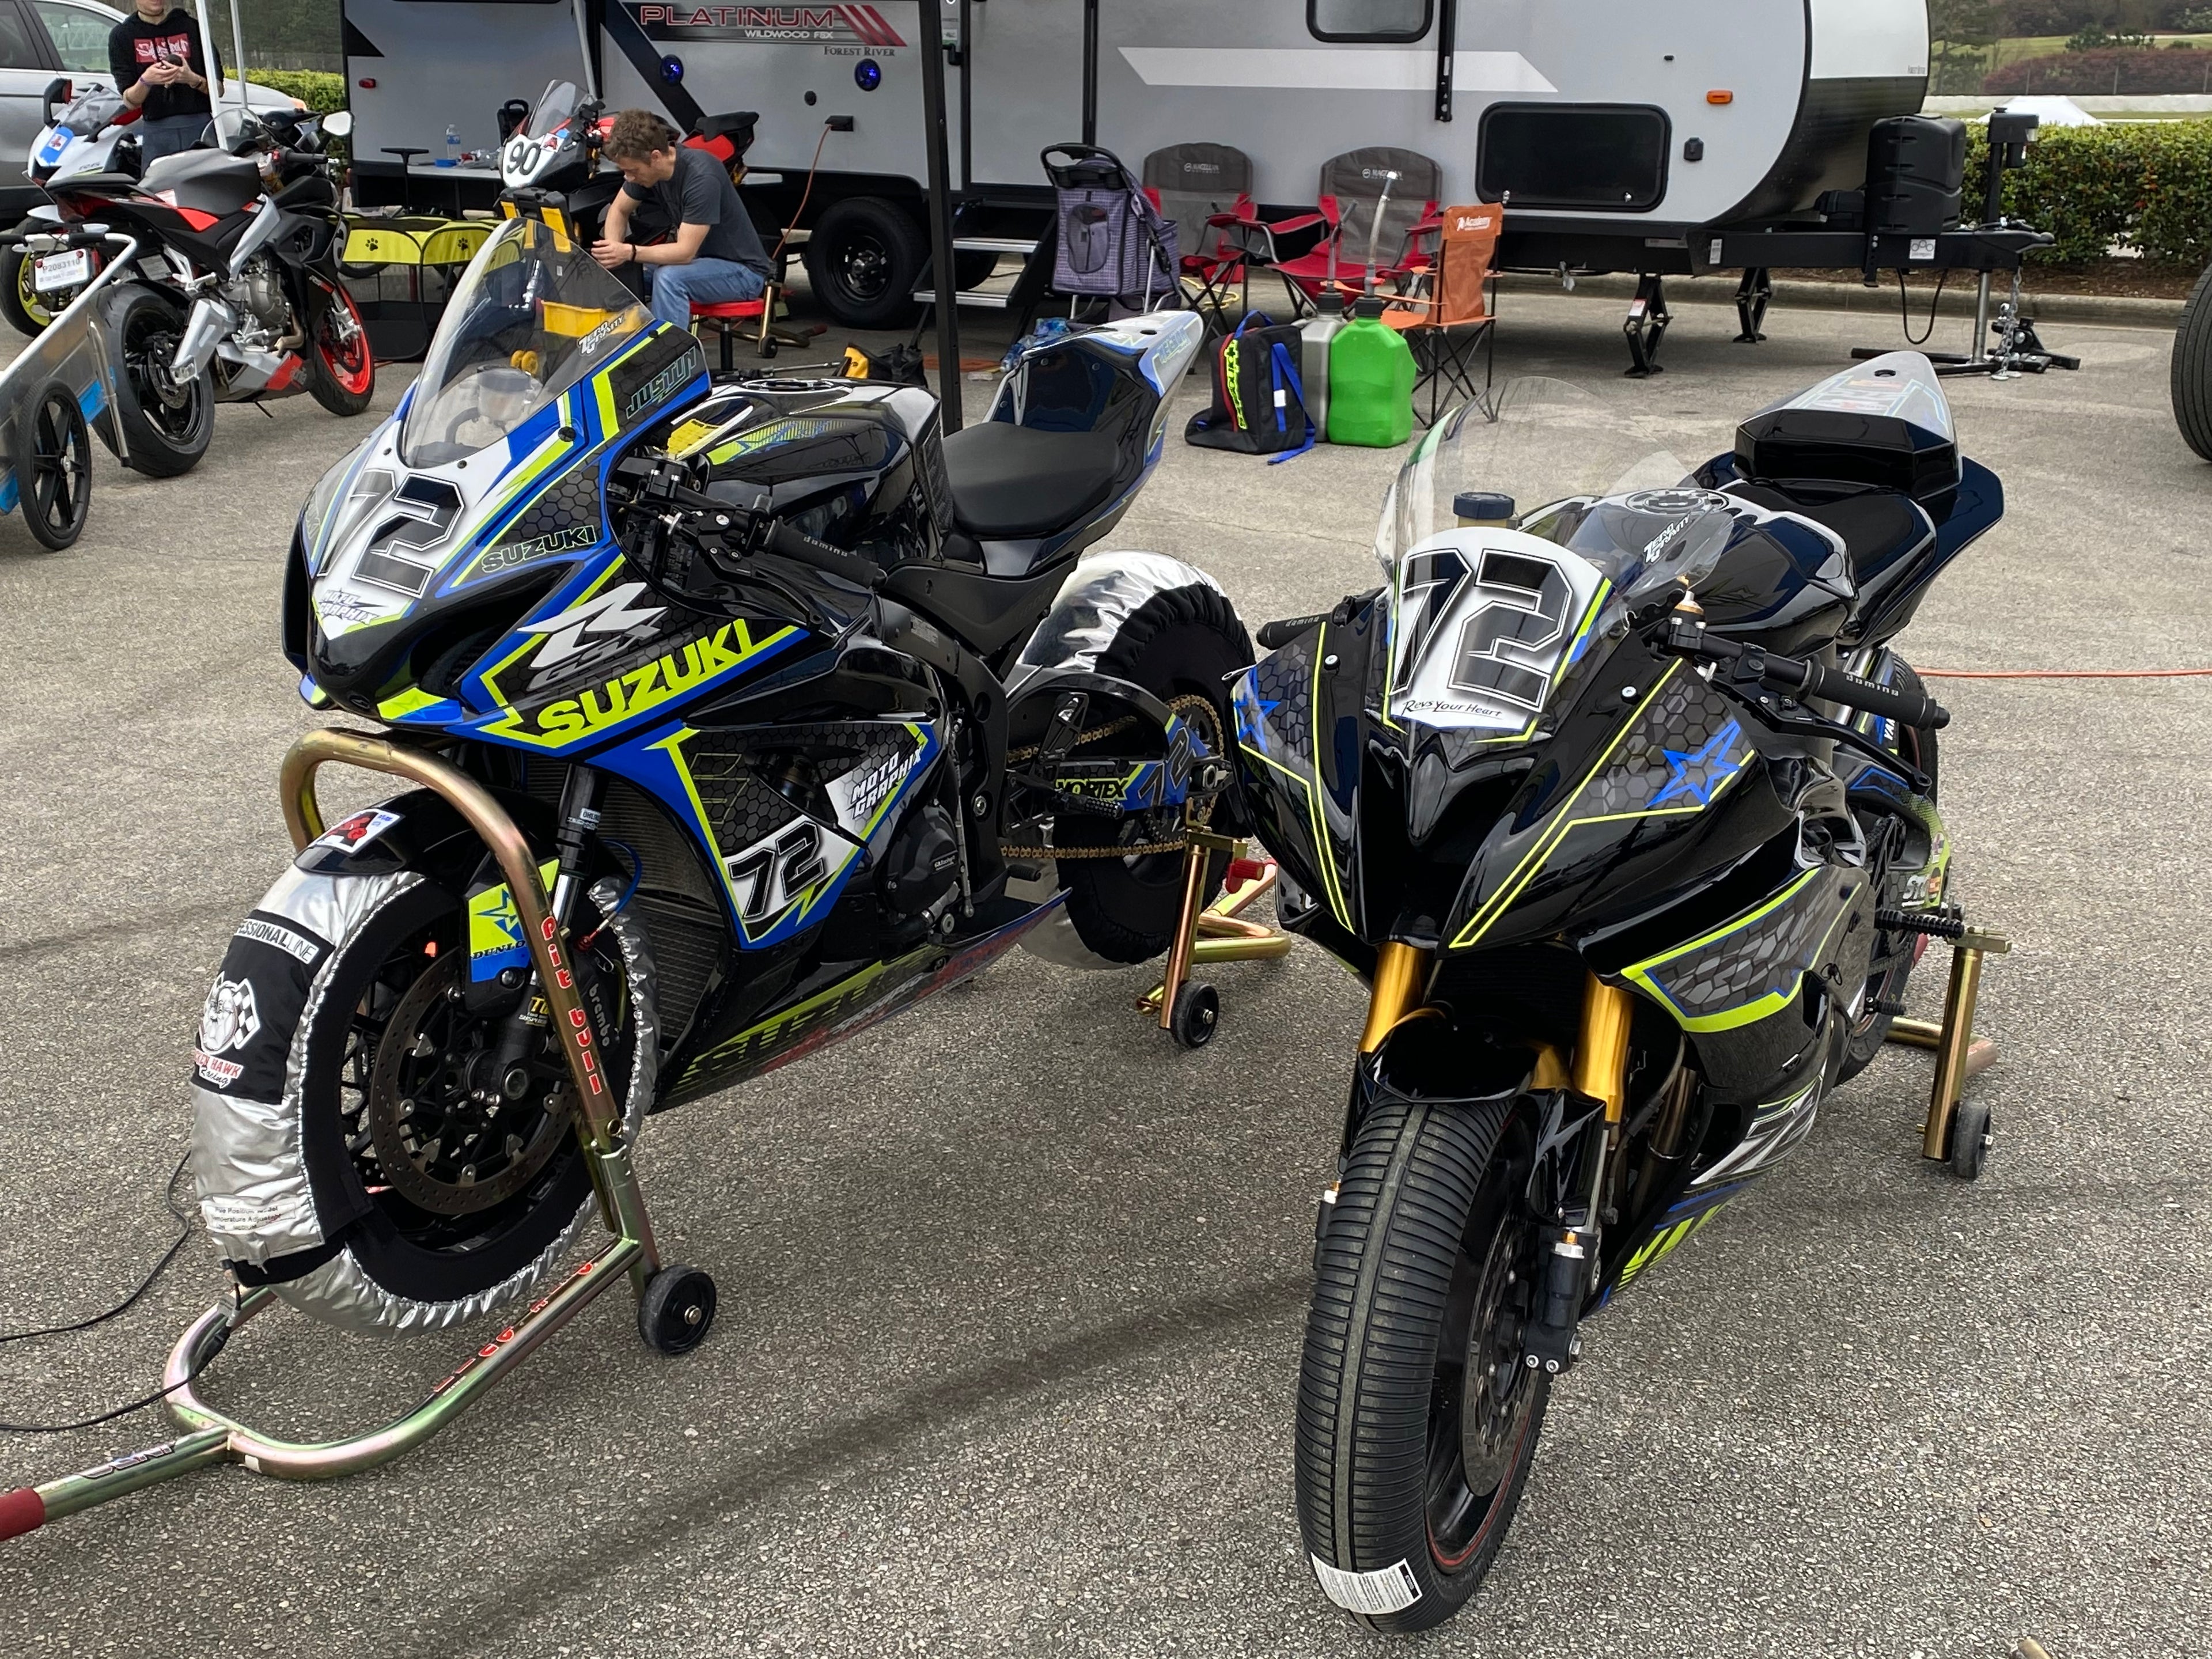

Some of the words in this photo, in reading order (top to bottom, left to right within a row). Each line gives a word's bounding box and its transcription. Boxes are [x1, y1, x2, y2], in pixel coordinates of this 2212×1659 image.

[640, 5, 835, 28] PLATINUM
[745, 29, 810, 39] WILDWOOD
[823, 46, 862, 56] FOREST
[863, 46, 896, 57] RIVER
[506, 141, 542, 176] 90
[578, 321, 608, 354] ZERO
[626, 346, 696, 419] JUSTIN
[316, 468, 466, 600] 72
[481, 525, 597, 573] SUZUKI
[1643, 522, 1674, 563] ZERO
[1389, 547, 1574, 713] 72
[537, 618, 749, 737] SUZUKI
[1401, 699, 1434, 717] Revs
[1432, 700, 1466, 713] Your
[1465, 704, 1502, 717] Heart
[851, 751, 900, 803] MOTO
[854, 744, 923, 818] GRAPHIX
[728, 820, 825, 919] 72
[470, 940, 527, 961] DUNLO
[588, 982, 611, 1047] brembo
[210, 1058, 241, 1077] HAWK
